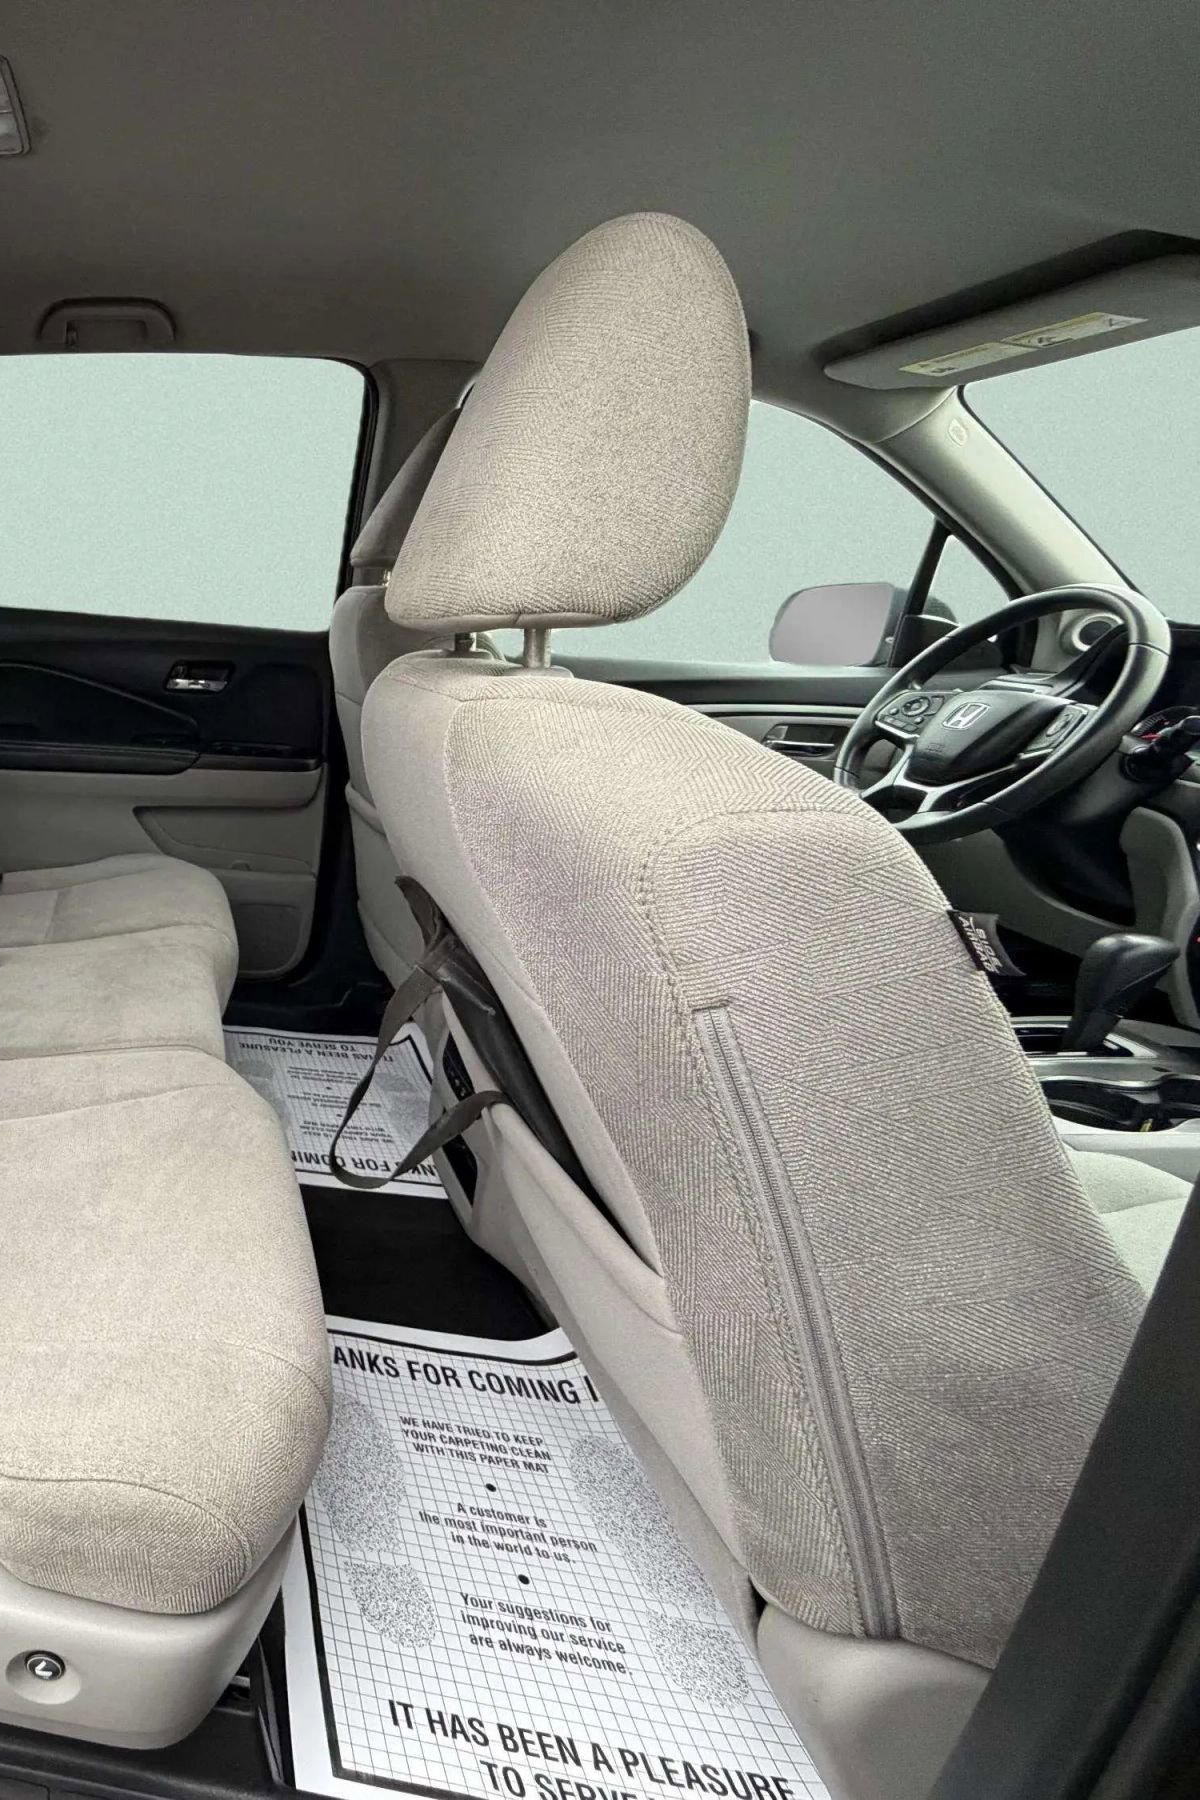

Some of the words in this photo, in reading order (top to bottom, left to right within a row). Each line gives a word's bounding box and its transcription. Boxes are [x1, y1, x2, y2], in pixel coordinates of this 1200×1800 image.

[352, 1157, 391, 1172] FOR
[406, 1359, 462, 1389] FOR
[467, 1369, 581, 1404] COMING
[400, 1415, 420, 1427] WE
[422, 1419, 454, 1433] HAVE
[455, 1424, 491, 1439] TRIED
[494, 1431, 511, 1443] TO
[513, 1434, 544, 1447] KEEP
[402, 1428, 437, 1442] YOUR
[439, 1434, 508, 1455] CARPETING
[511, 1446, 551, 1461] CLEAN
[412, 1442, 446, 1456] WITH
[448, 1448, 477, 1462] THIS
[479, 1453, 521, 1469] PAPER
[523, 1460, 550, 1474] MAT
[419, 1511, 440, 1525] the
[444, 1517, 478, 1532] most
[480, 1521, 548, 1544] important
[550, 1534, 598, 1553] person
[457, 1502, 467, 1514] A
[469, 1505, 531, 1525] customer
[533, 1515, 548, 1529] is
[450, 1531, 465, 1545] in
[468, 1533, 490, 1549] the
[494, 1541, 533, 1556] world
[536, 1547, 550, 1560] to
[553, 1552, 576, 1564] us.
[460, 1592, 494, 1610] Your
[497, 1601, 588, 1629] suggestions
[590, 1616, 612, 1633] for
[460, 1610, 538, 1640] improving
[540, 1628, 565, 1643] our
[569, 1634, 626, 1655] service
[469, 1633, 494, 1649] are
[498, 1638, 552, 1661] always
[555, 1650, 633, 1676] welcome.
[388, 1699, 414, 1729] IT
[424, 1707, 490, 1747] HAS
[496, 1723, 583, 1767] BEEN
[591, 1742, 615, 1774] A
[617, 1747, 794, 1800] PLEASURE
[479, 1759, 527, 1798] TO
[534, 1773, 637, 1800] SER
